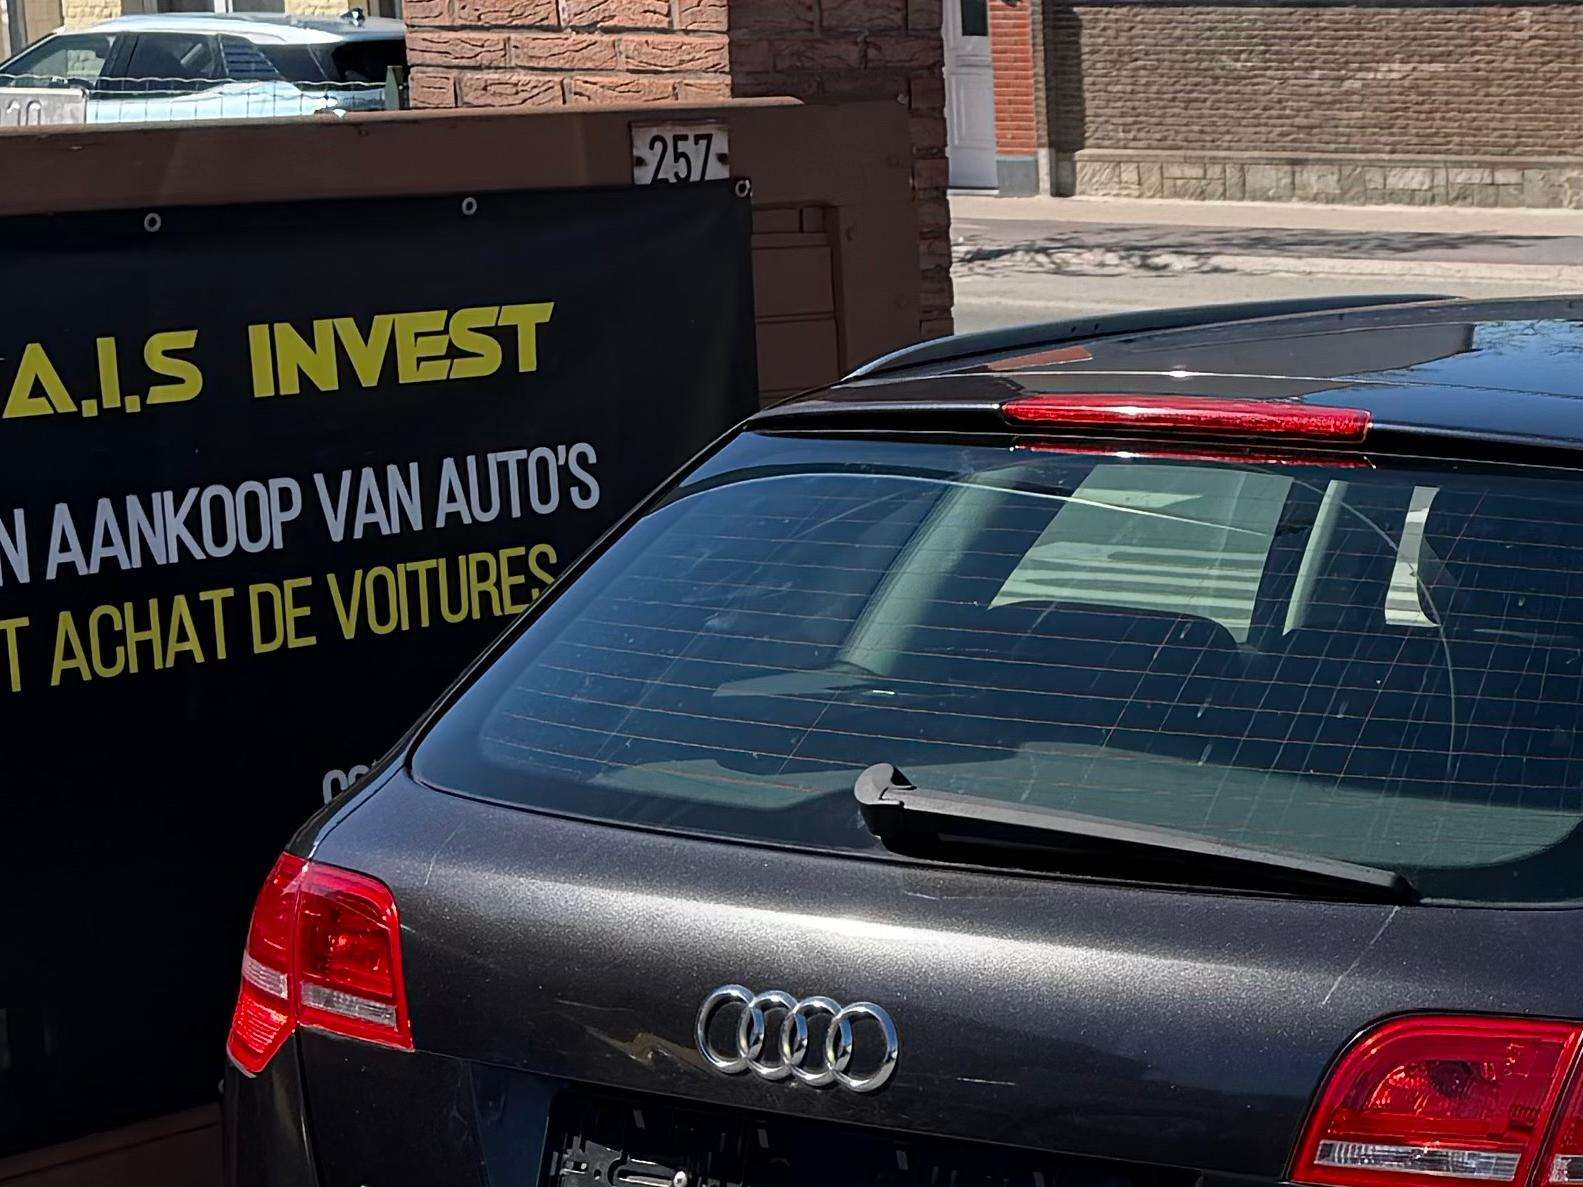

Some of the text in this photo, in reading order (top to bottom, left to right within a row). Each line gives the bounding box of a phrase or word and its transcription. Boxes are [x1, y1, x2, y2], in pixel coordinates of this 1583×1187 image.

[649, 132, 714, 184] 257
[2, 302, 555, 419] A.I.S INVEST
[46, 477, 302, 580] AANKOOP
[313, 461, 424, 542] VAN
[436, 443, 600, 529] AUTO'S
[51, 588, 235, 686] ACHAT
[249, 577, 317, 654] DE
[326, 543, 558, 640] VOITURES
